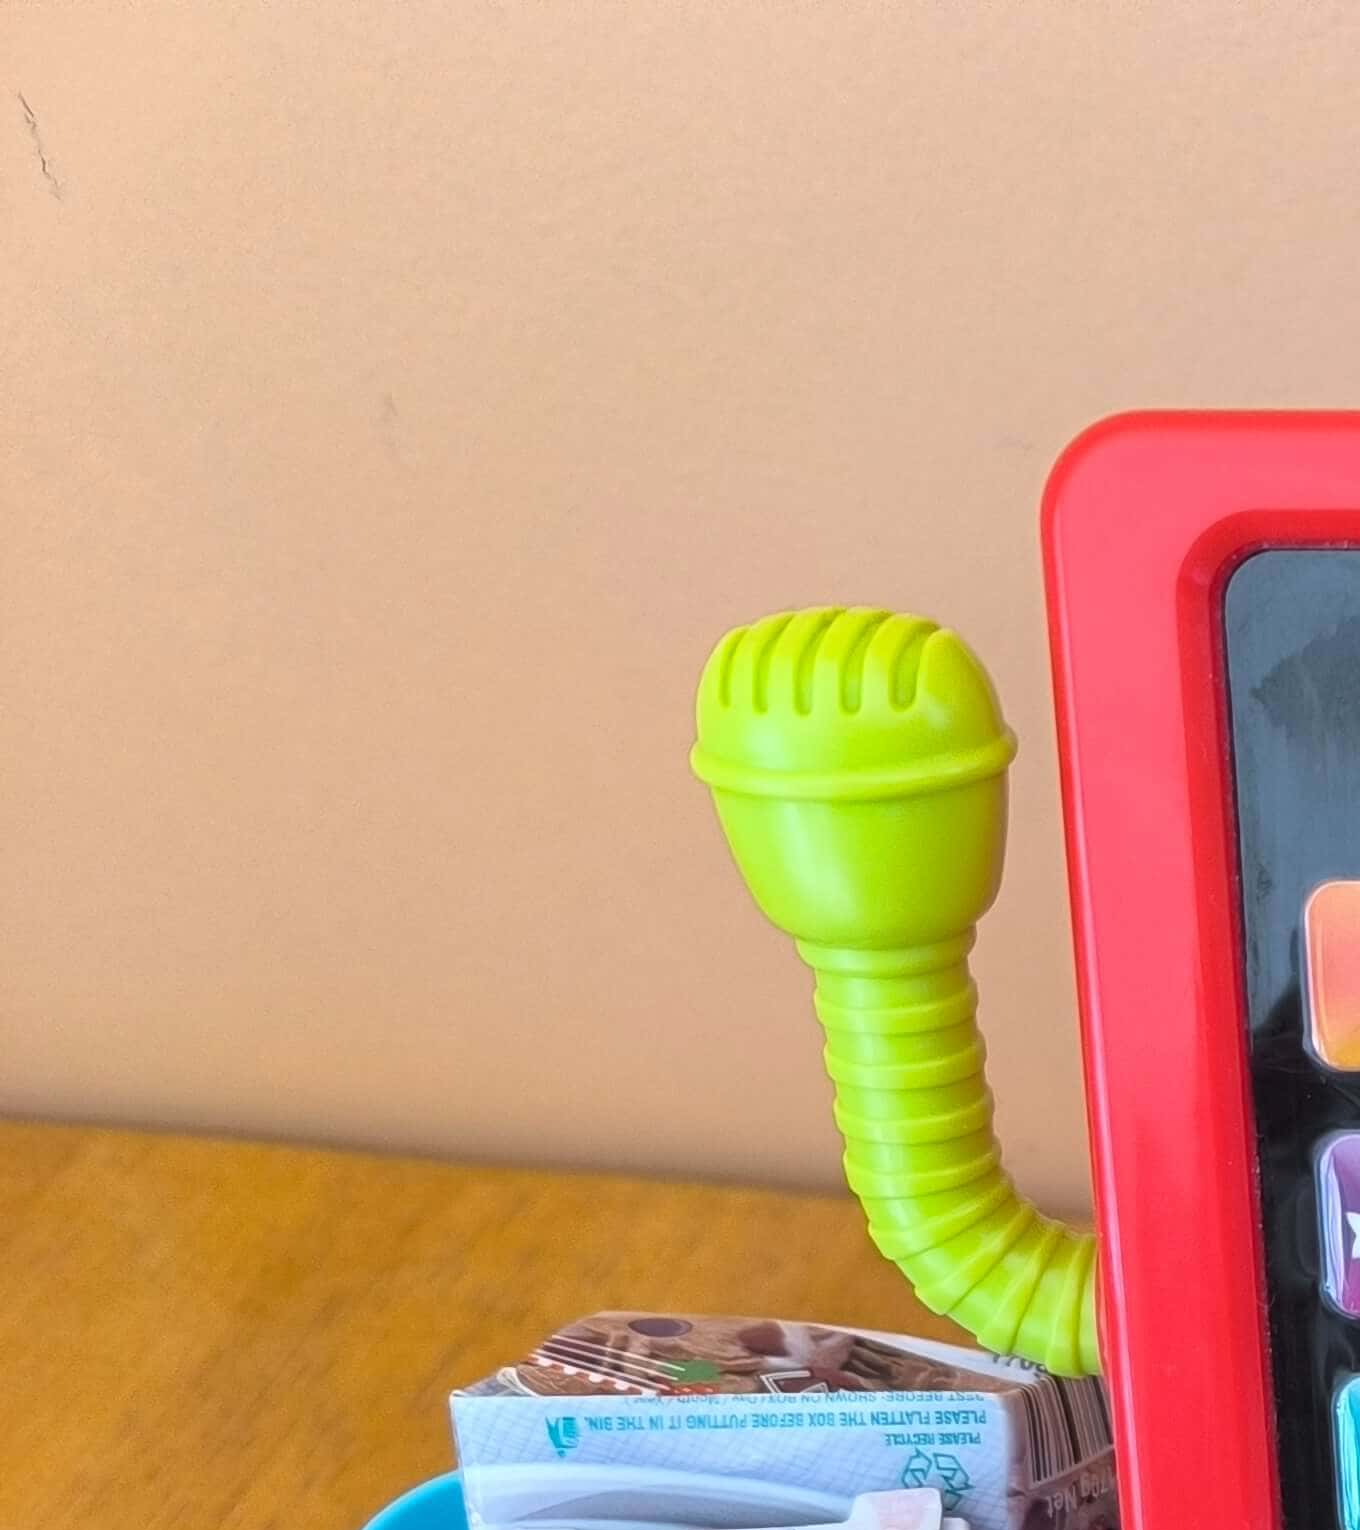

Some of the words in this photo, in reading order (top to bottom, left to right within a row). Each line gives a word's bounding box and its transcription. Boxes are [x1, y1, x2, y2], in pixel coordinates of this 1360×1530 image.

[616, 1415, 645, 1431] THE
[649, 1415, 664, 1431] IN
[668, 1414, 685, 1430] IT
[686, 1413, 748, 1430] PUTTING
[751, 1412, 804, 1429] BEFORE
[807, 1412, 835, 1428] BOX
[839, 1411, 867, 1427] THE
[870, 1410, 931, 1426] FLATTEN
[935, 1409, 987, 1425] PLEASE
[884, 1432, 936, 1447] RECYCLE
[938, 1431, 982, 1446] PLEASE
[1046, 1489, 1078, 1518] Net
